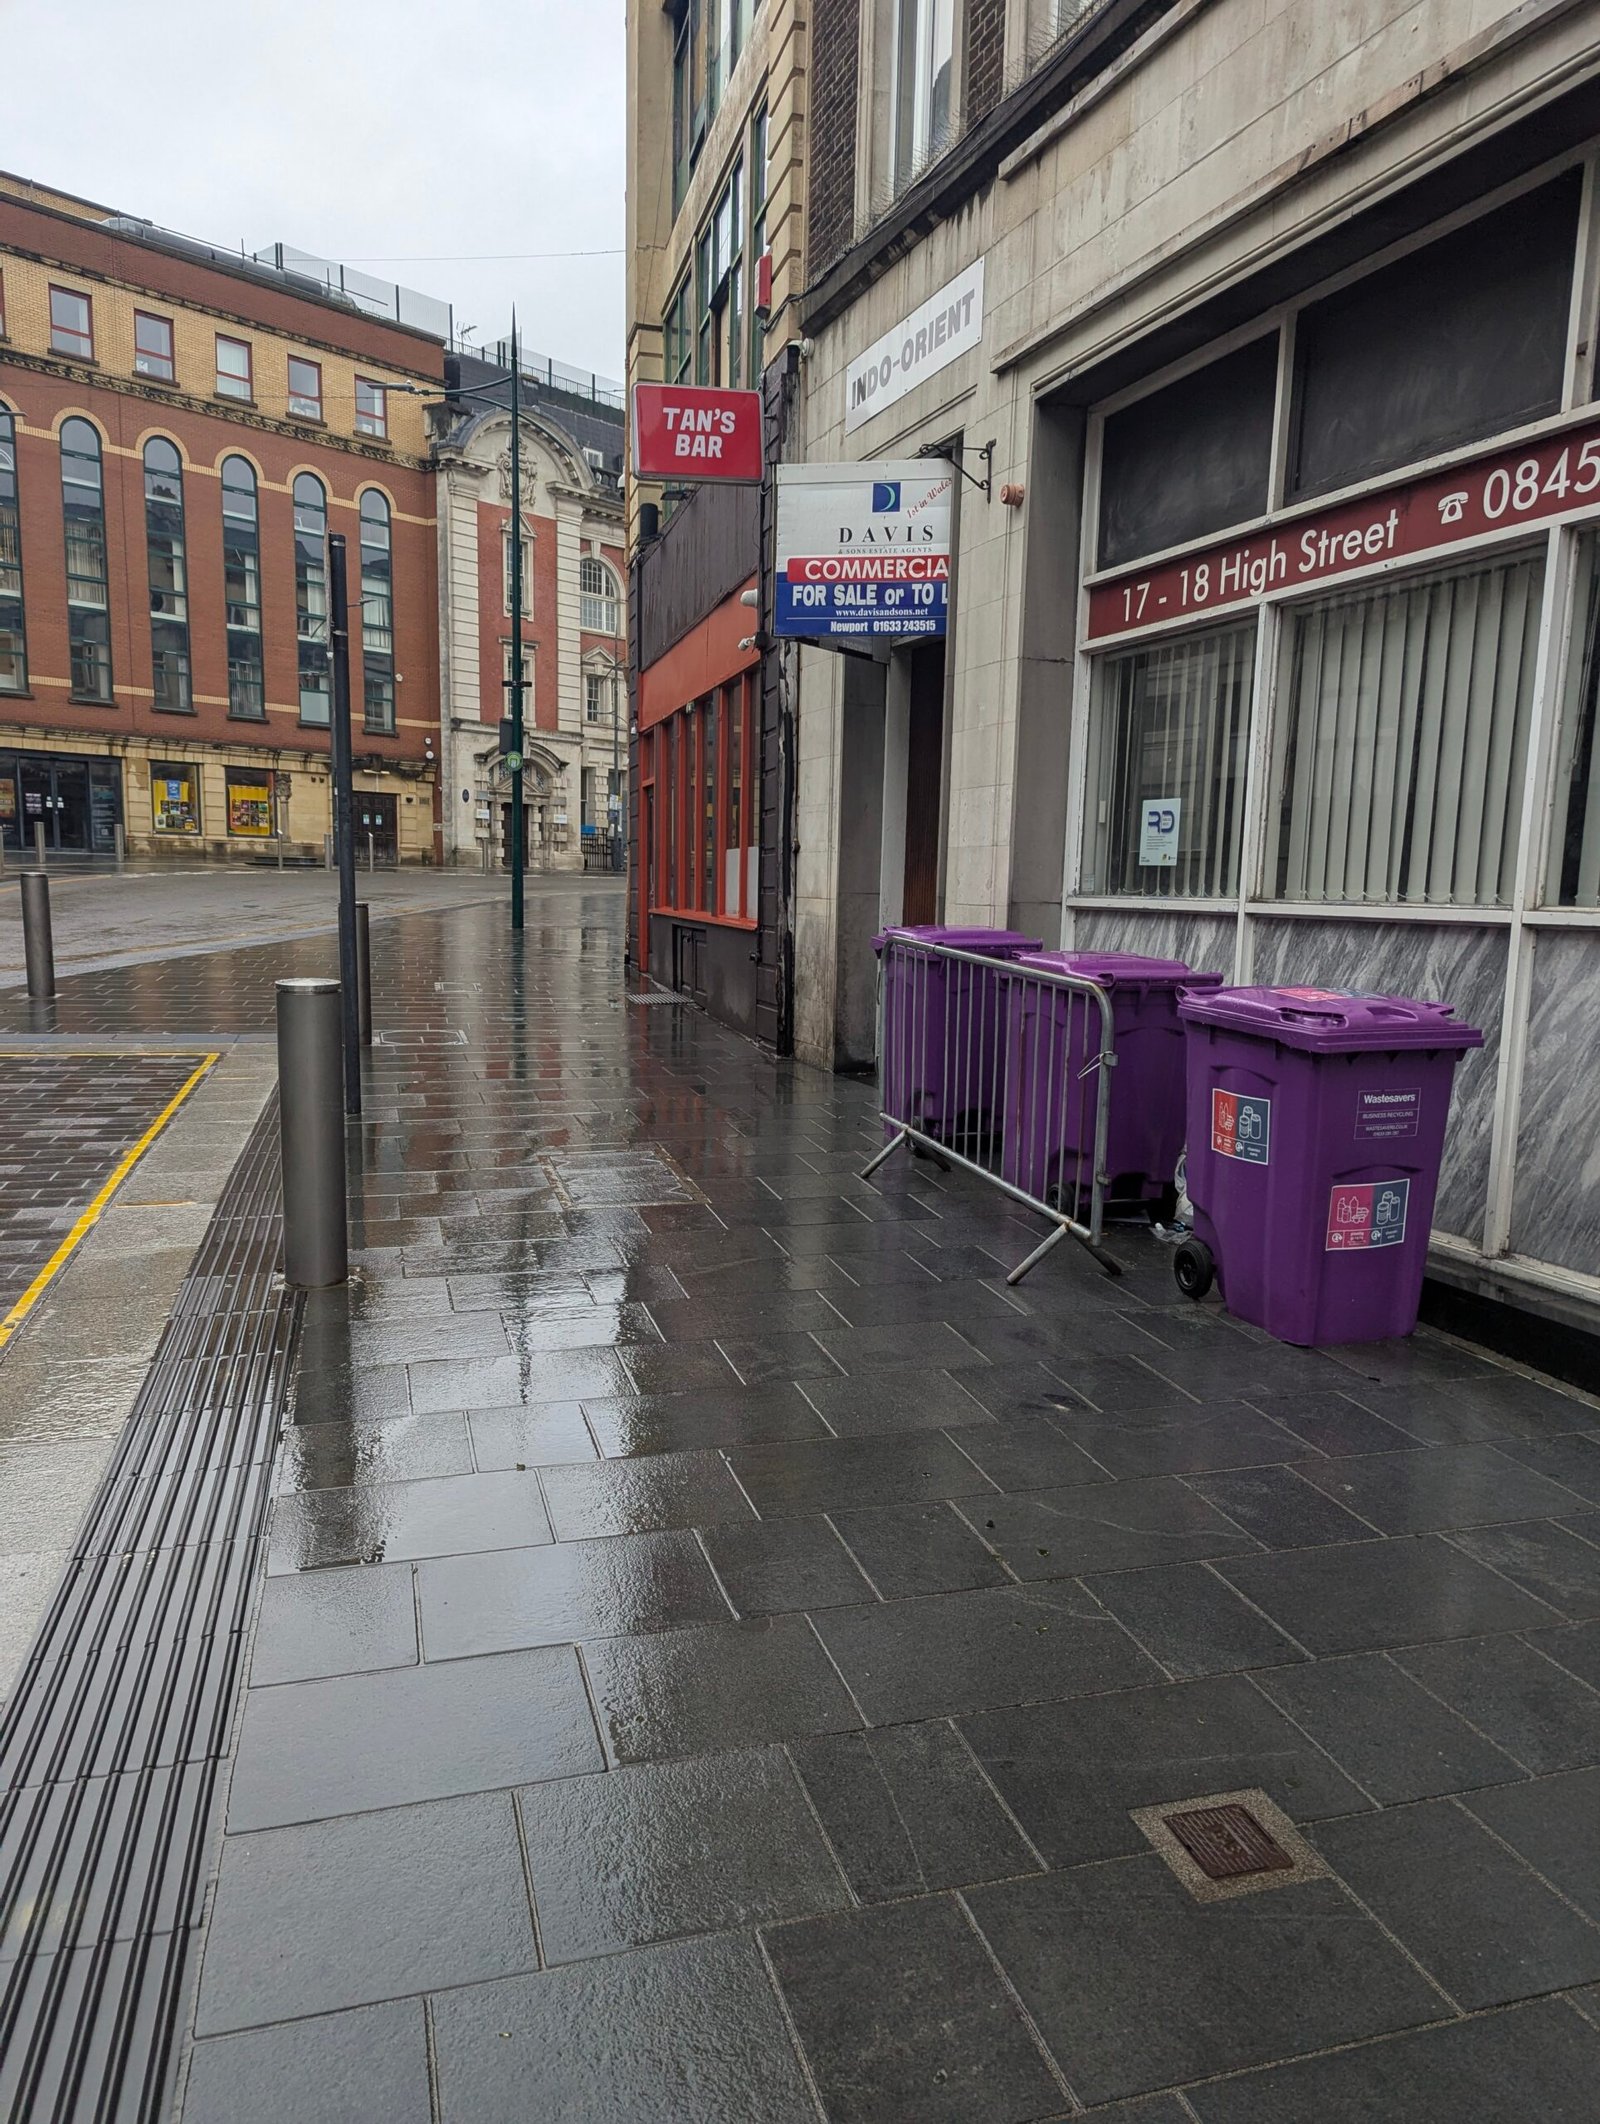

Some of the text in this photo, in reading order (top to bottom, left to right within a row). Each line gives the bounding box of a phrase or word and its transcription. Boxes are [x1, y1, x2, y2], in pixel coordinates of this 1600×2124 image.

[851, 288, 975, 410] INDO-ORIENT
[662, 407, 736, 434] TAN'S
[675, 433, 723, 458] BAR
[907, 478, 952, 519] 1st in Wales
[839, 524, 934, 543] DAVIS
[1123, 581, 1151, 622] 17
[1179, 564, 1209, 606] 18
[1219, 540, 1286, 595] High
[1298, 509, 1399, 574] Street
[1483, 438, 1600, 519] 0845
[846, 547, 866, 555] SONS
[869, 546, 898, 554] ESTATE
[900, 545, 933, 554] AGENTS
[792, 584, 827, 607] FOR
[833, 584, 877, 606] SALE
[884, 588, 905, 606] or
[911, 583, 934, 605] TO
[835, 607, 928, 617] www.davisandsons.net
[830, 620, 936, 634] Newport 01633 243515
[1363, 1094, 1416, 1104] Wastesavers
